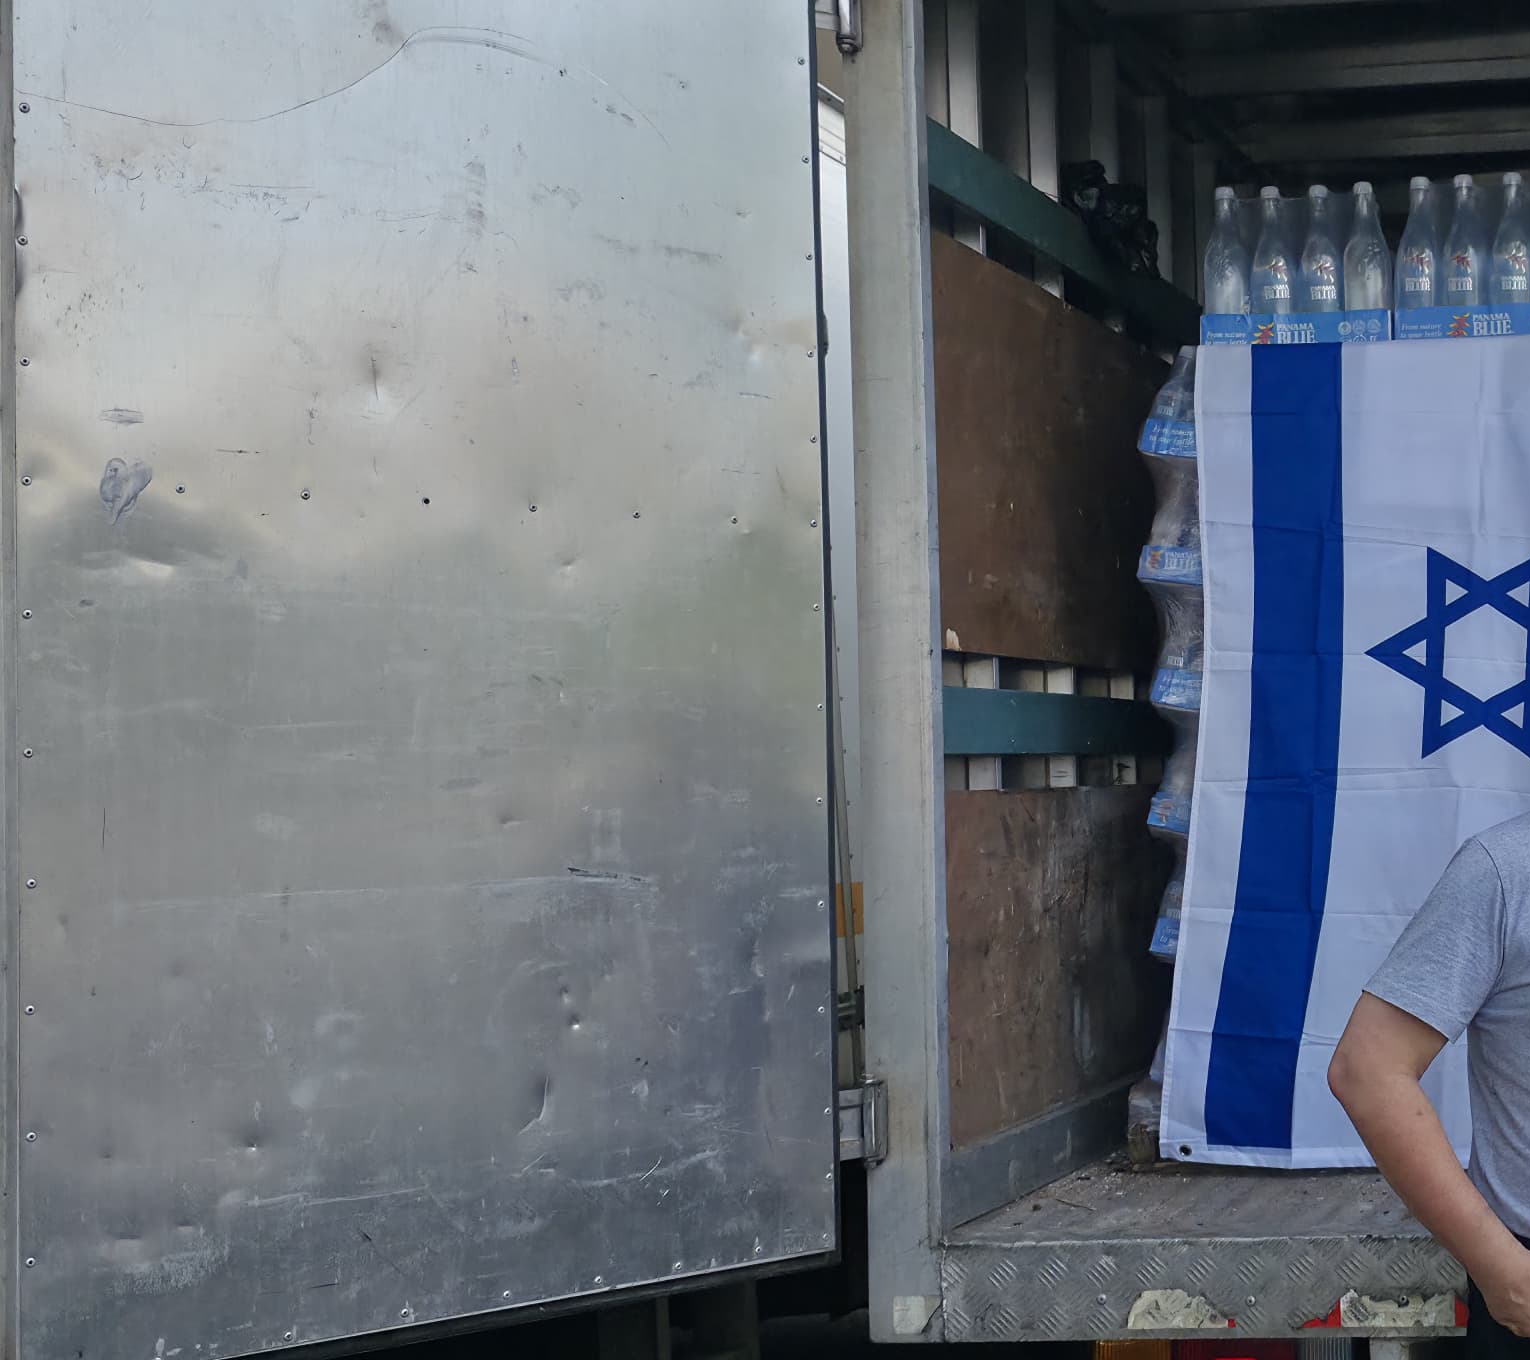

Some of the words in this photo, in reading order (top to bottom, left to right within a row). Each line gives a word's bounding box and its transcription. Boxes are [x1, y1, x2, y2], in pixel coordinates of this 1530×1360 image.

[1473, 312, 1510, 321] PANAMA
[1277, 323, 1314, 331] PANAMA
[1473, 320, 1512, 336] BLUE
[1278, 331, 1315, 344] BLUE
